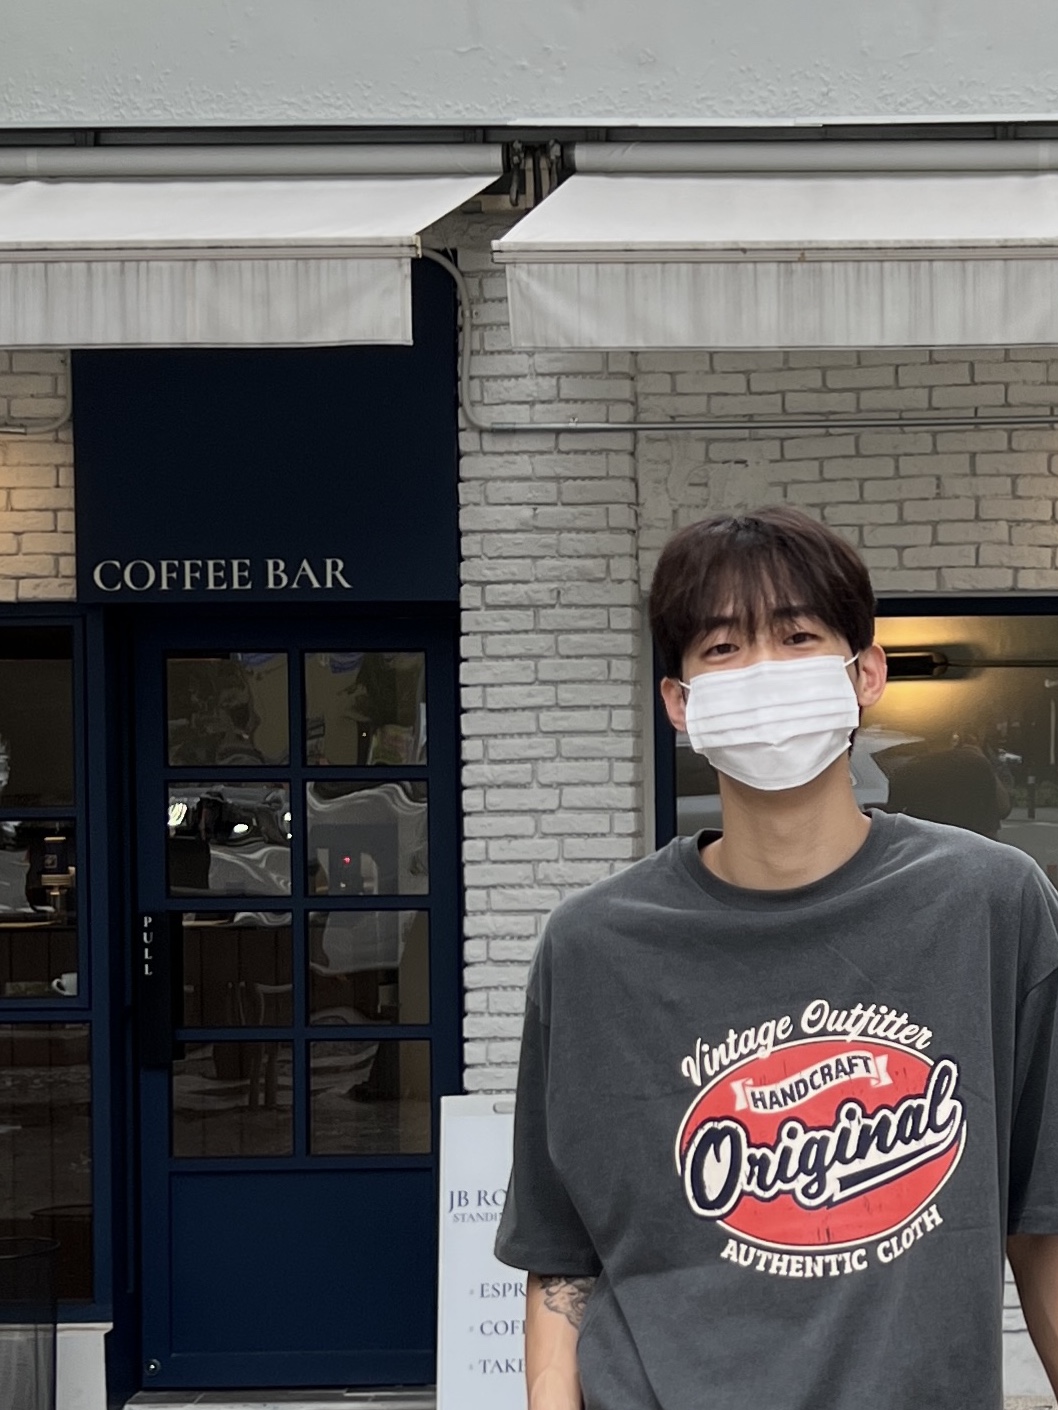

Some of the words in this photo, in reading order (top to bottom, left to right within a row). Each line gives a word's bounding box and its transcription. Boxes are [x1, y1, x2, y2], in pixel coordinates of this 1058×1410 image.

[93, 559, 252, 591] COFFEE
[266, 558, 353, 589] BAR
[142, 915, 154, 976] PULL
[681, 1013, 794, 1086] Vintage
[801, 998, 934, 1050] Outfitter
[750, 1054, 873, 1111] HANDCRAFT
[687, 1057, 961, 1217] Original
[448, 1189, 470, 1213] JB
[720, 1238, 868, 1278] AUTHENTIC
[876, 1203, 944, 1264] CLOTH
[480, 1282, 527, 1298] ESPR
